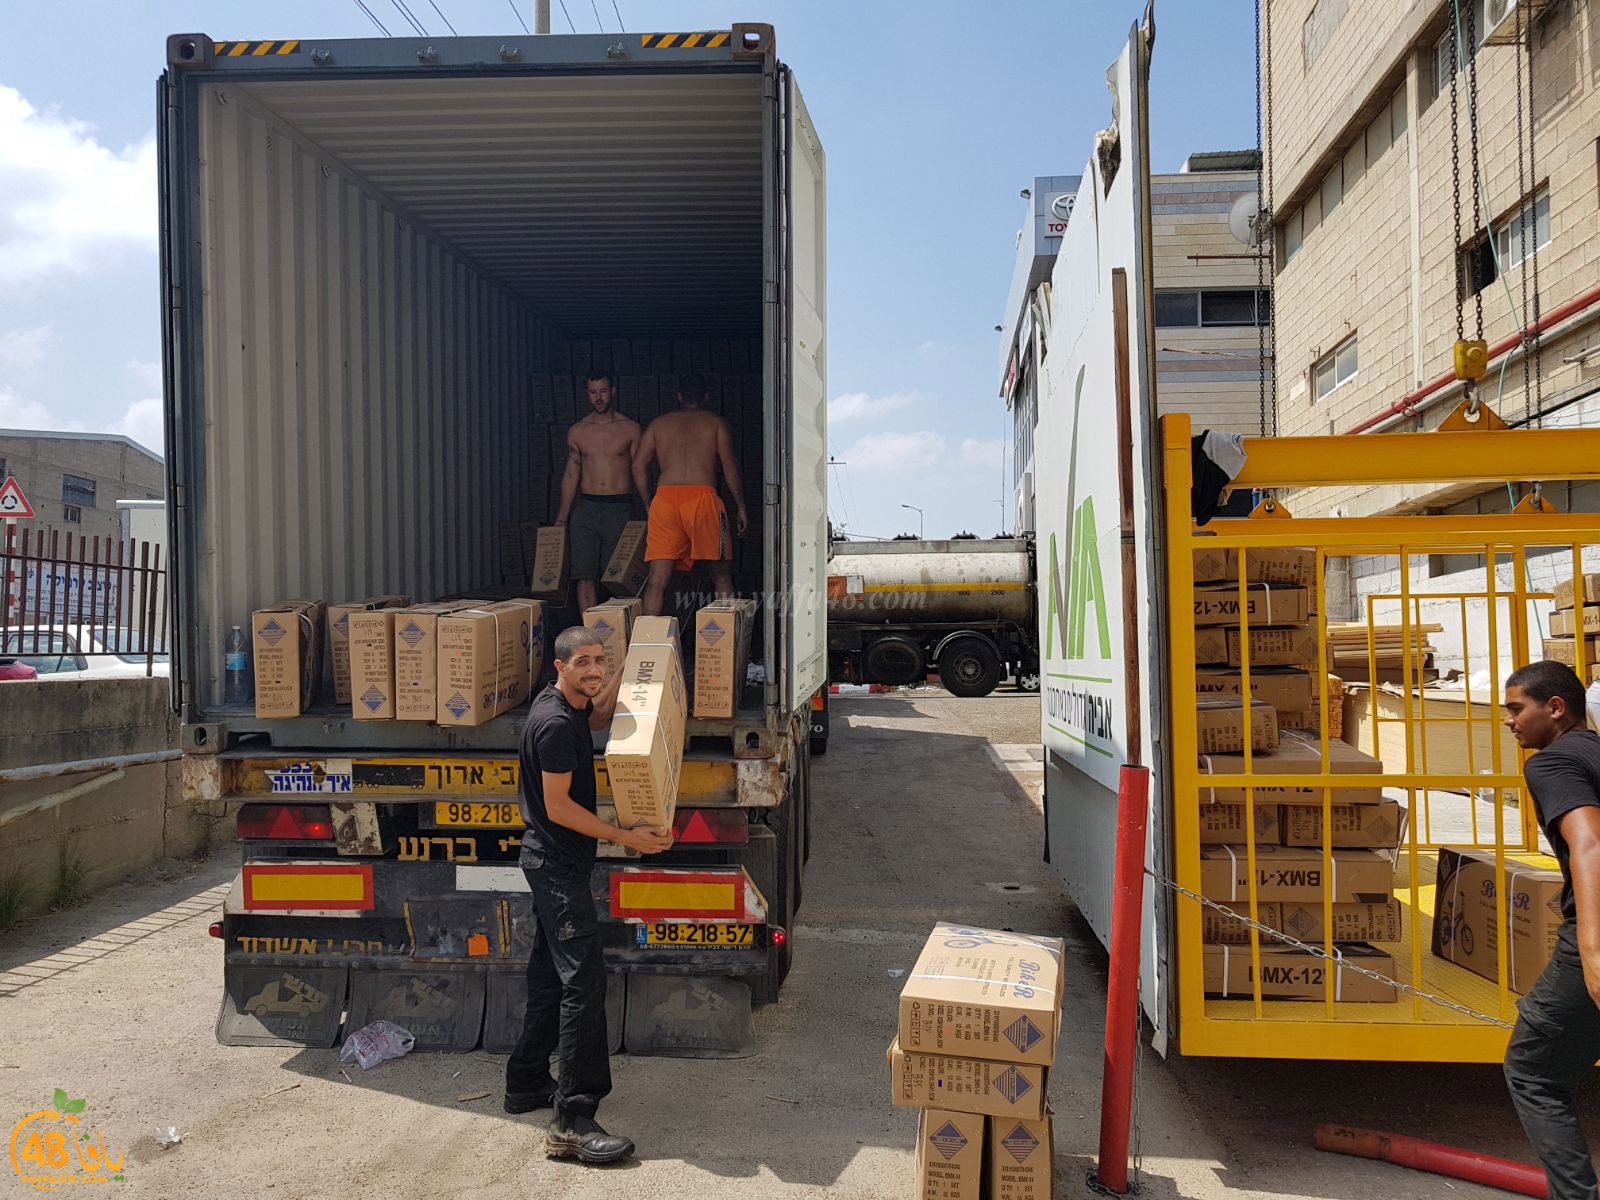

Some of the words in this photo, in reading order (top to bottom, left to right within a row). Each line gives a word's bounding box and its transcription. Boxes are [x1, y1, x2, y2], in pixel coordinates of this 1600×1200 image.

[630, 660, 655, 707] BMX-14"
[326, 775, 350, 792] איך
[429, 764, 484, 789] ארוך
[397, 836, 478, 861] ברנע
[237, 936, 317, 954] אשדוד
